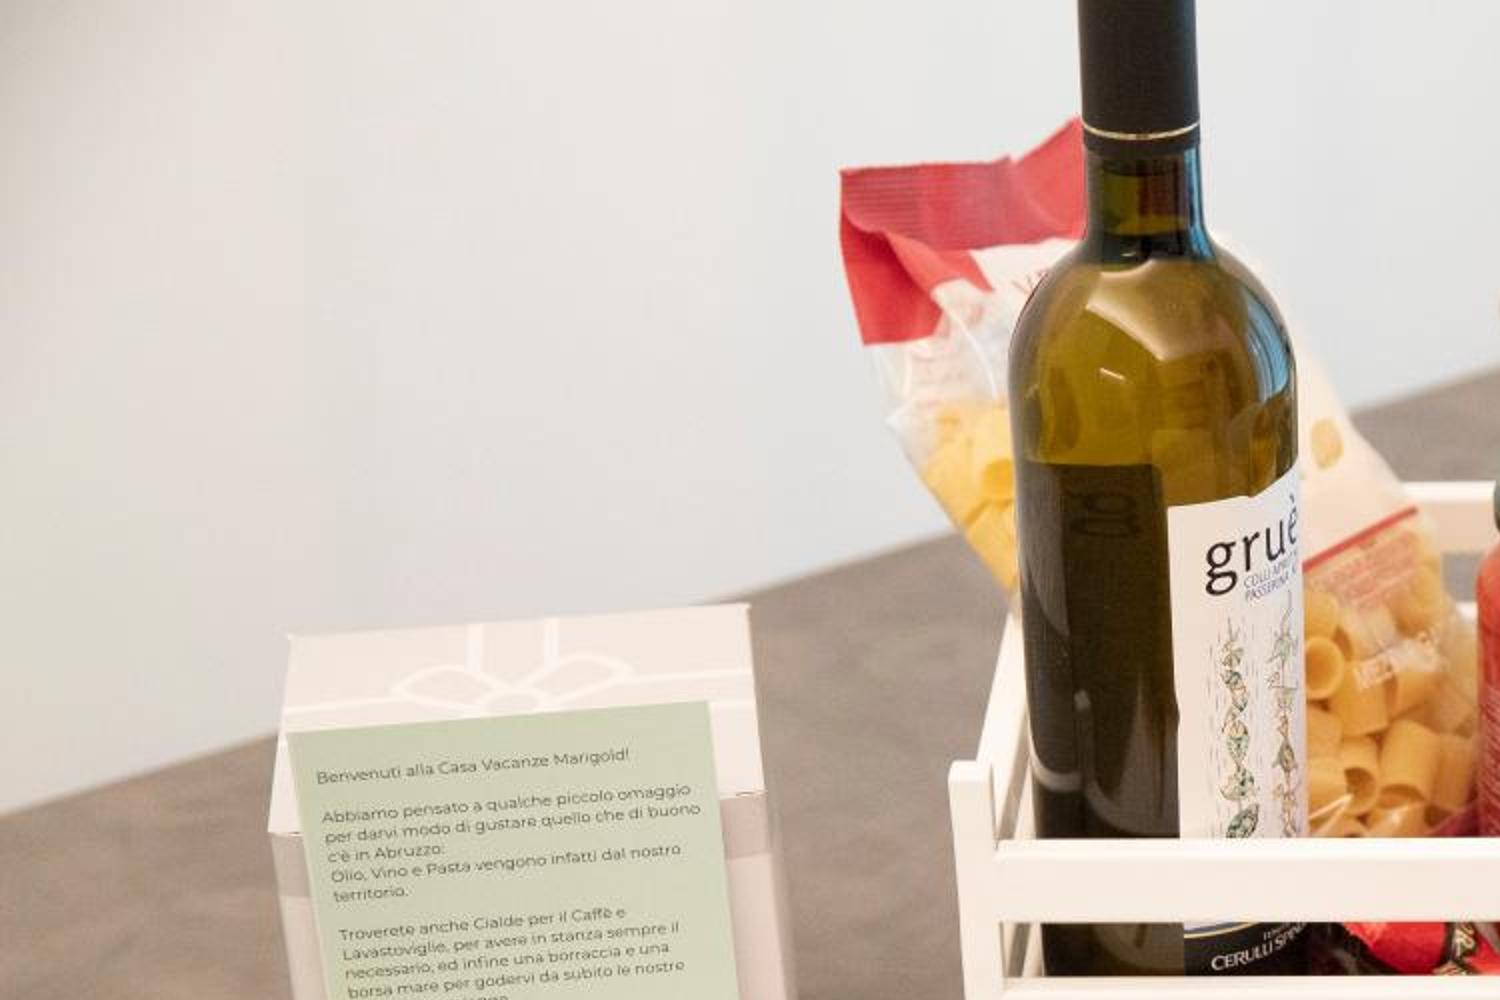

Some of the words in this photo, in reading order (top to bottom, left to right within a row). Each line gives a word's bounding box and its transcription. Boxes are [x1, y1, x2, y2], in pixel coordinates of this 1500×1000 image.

[317, 765, 401, 785] Benvenuti
[406, 761, 434, 777] alla
[438, 761, 478, 775] Casa
[480, 756, 549, 772] Vacanze
[553, 748, 629, 767] Marigold!
[322, 805, 398, 824] Abbiamo
[403, 801, 468, 819] pensato
[473, 802, 483, 812] a
[486, 795, 552, 813] qualche
[557, 789, 614, 808] piccolo
[618, 784, 691, 802] omaggio
[325, 831, 351, 847] per
[357, 826, 398, 841] darvi
[401, 822, 451, 837] modo
[455, 820, 471, 833] di
[476, 817, 536, 834] gustare
[541, 812, 590, 829] quello
[595, 808, 624, 822] che
[629, 806, 643, 819] di
[647, 802, 702, 817] buono
[355, 849, 370, 861] in
[371, 865, 408, 880] Vino
[411, 867, 422, 876] e
[427, 862, 471, 876] Pasta
[475, 855, 547, 873] vengono
[602, 847, 626, 860] dal
[631, 844, 681, 858] nostro
[333, 886, 409, 902] territorio.
[339, 924, 415, 941] Troverete
[420, 920, 469, 935] anche
[474, 915, 524, 930] Cialde
[528, 914, 556, 928] per
[559, 911, 568, 923] il
[616, 908, 626, 918] e
[344, 942, 451, 961] Lavastoviglie,
[454, 938, 482, 953] per
[486, 935, 527, 948] avere
[532, 933, 546, 944] in
[551, 929, 602, 942] stanza
[607, 924, 668, 939] sempre
[672, 921, 680, 934] il
[438, 959, 459, 971] ed
[463, 954, 509, 969] infine
[514, 953, 545, 966] una
[549, 948, 621, 963] borraccia
[625, 947, 635, 957] e
[640, 944, 669, 955] una
[348, 984, 394, 999] borsa
[398, 981, 439, 994] mare
[444, 979, 470, 993] per
[475, 973, 535, 991] godervi
[540, 970, 560, 982] da
[564, 966, 613, 980] subito
[617, 964, 630, 976] le
[635, 960, 685, 974] nostro
